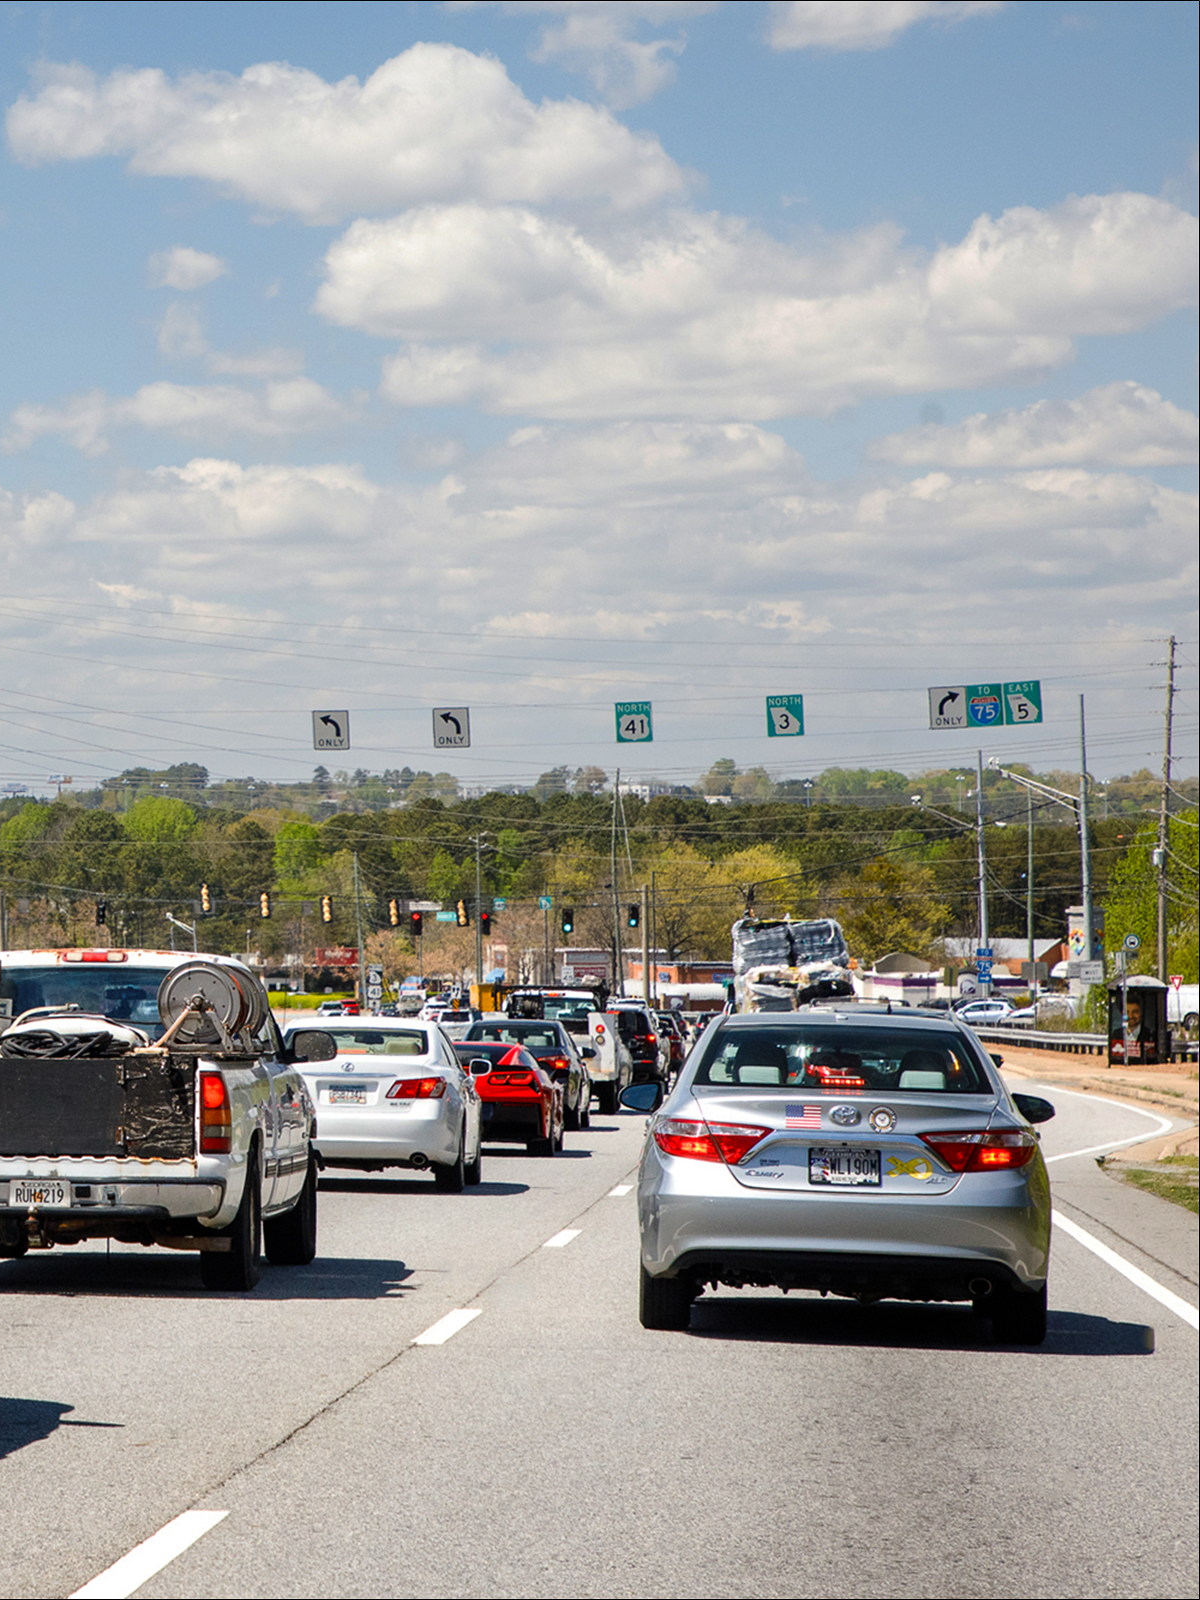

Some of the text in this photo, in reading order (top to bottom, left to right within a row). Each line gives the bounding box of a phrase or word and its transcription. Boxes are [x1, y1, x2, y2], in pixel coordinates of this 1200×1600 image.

[977, 686, 991, 695] TO
[1008, 683, 1035, 693] EAST
[768, 696, 802, 706] NORTH
[617, 703, 651, 713] NORTH
[974, 705, 996, 720] 75
[1017, 703, 1029, 720] 5
[778, 713, 790, 730] 3
[935, 716, 963, 726] ONLY
[624, 719, 645, 734] 41
[318, 738, 345, 747] ONLY
[438, 736, 465, 745] ONLY
[980, 962, 991, 972] 75
[15, 1188, 65, 1203] RUH4219
